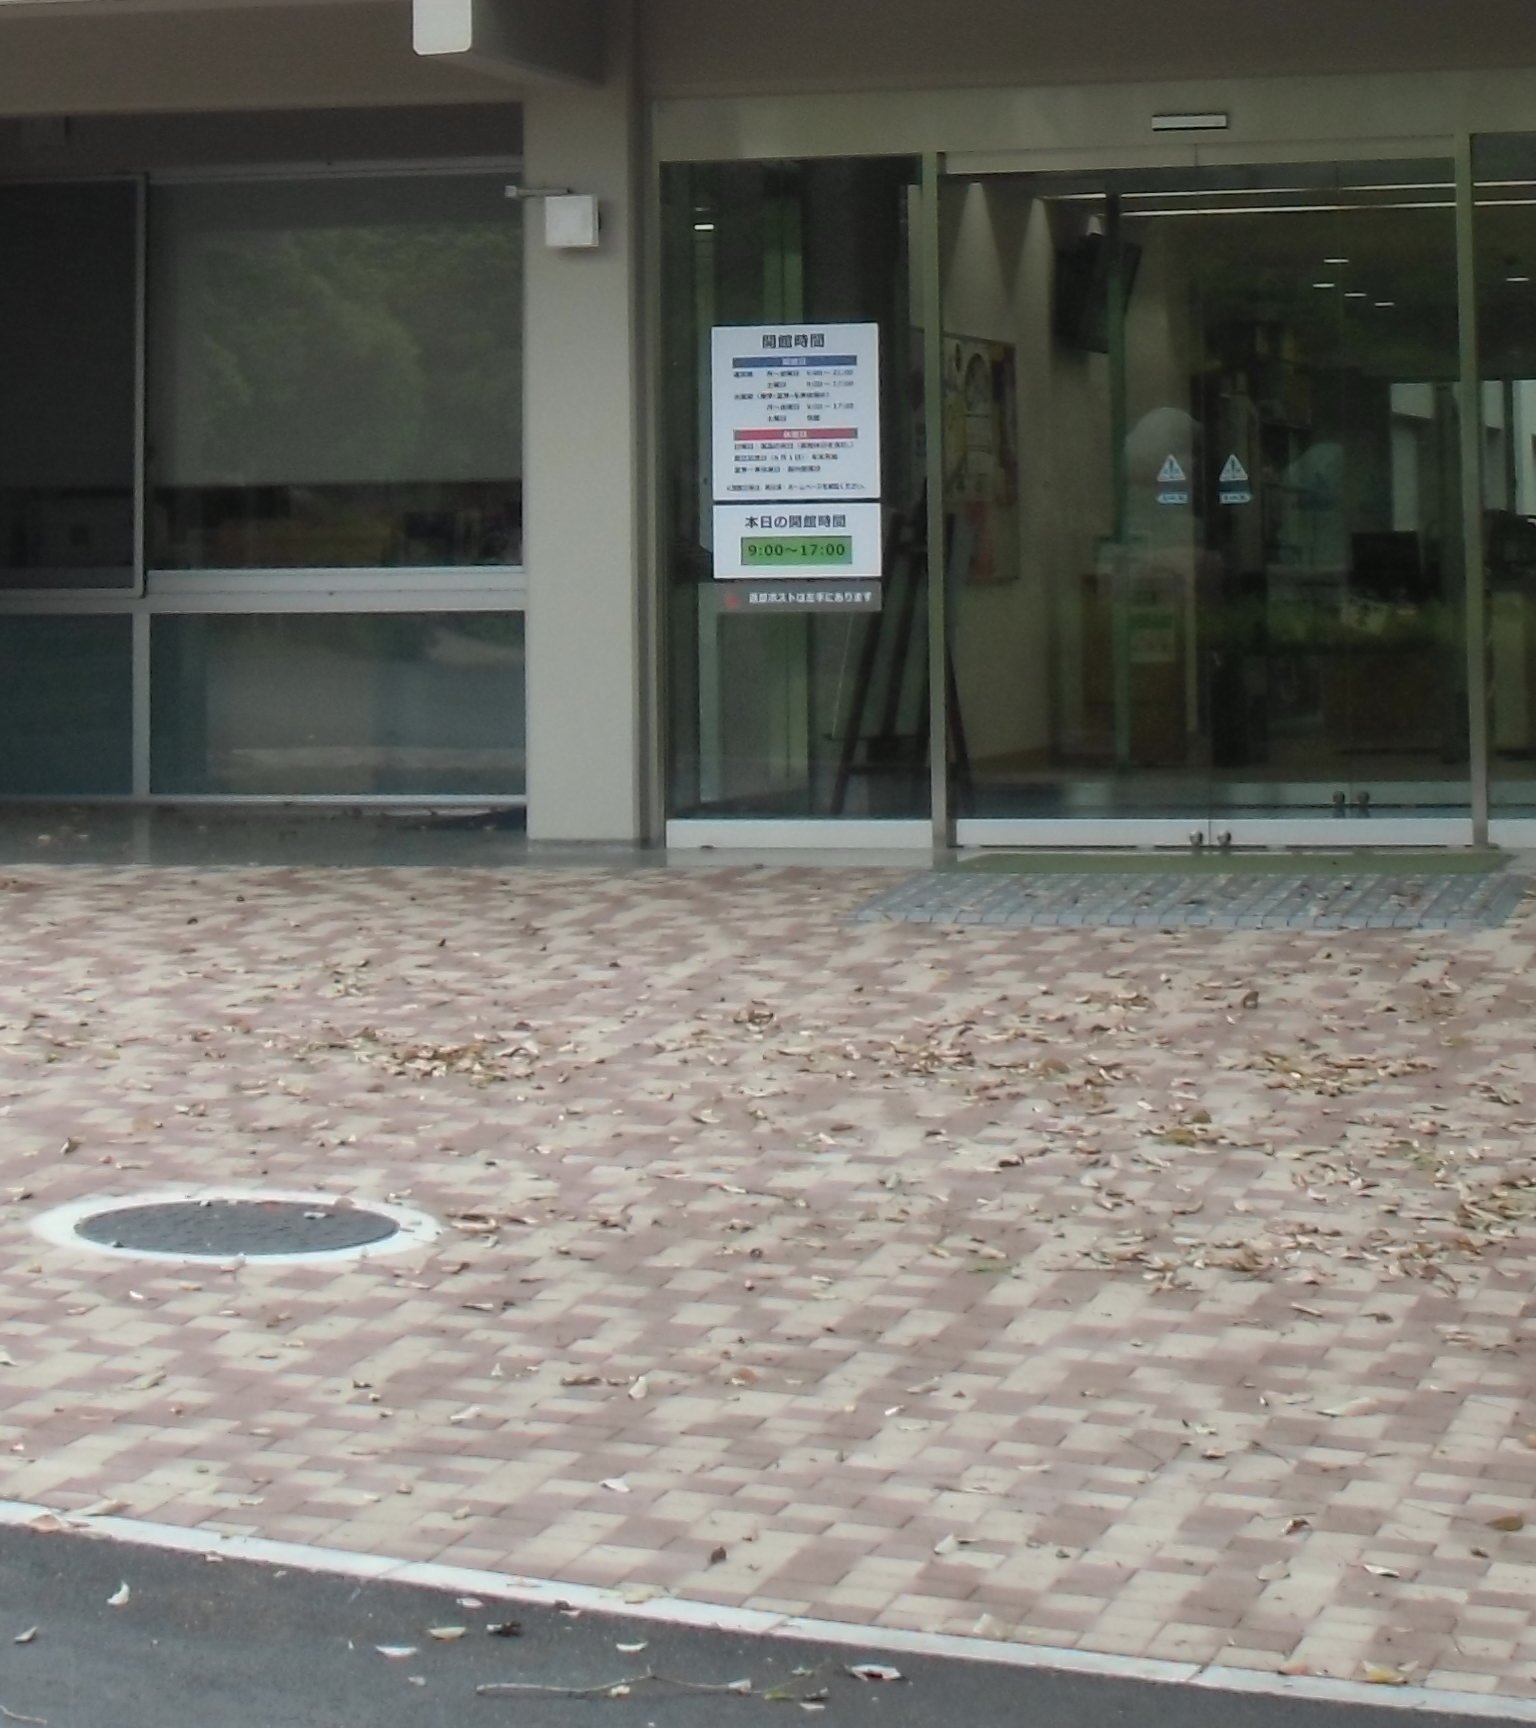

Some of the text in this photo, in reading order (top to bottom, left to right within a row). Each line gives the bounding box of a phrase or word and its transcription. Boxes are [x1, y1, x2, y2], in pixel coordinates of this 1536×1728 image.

[761, 333, 825, 349] 開館時間
[744, 514, 847, 529] 本日の開館時間
